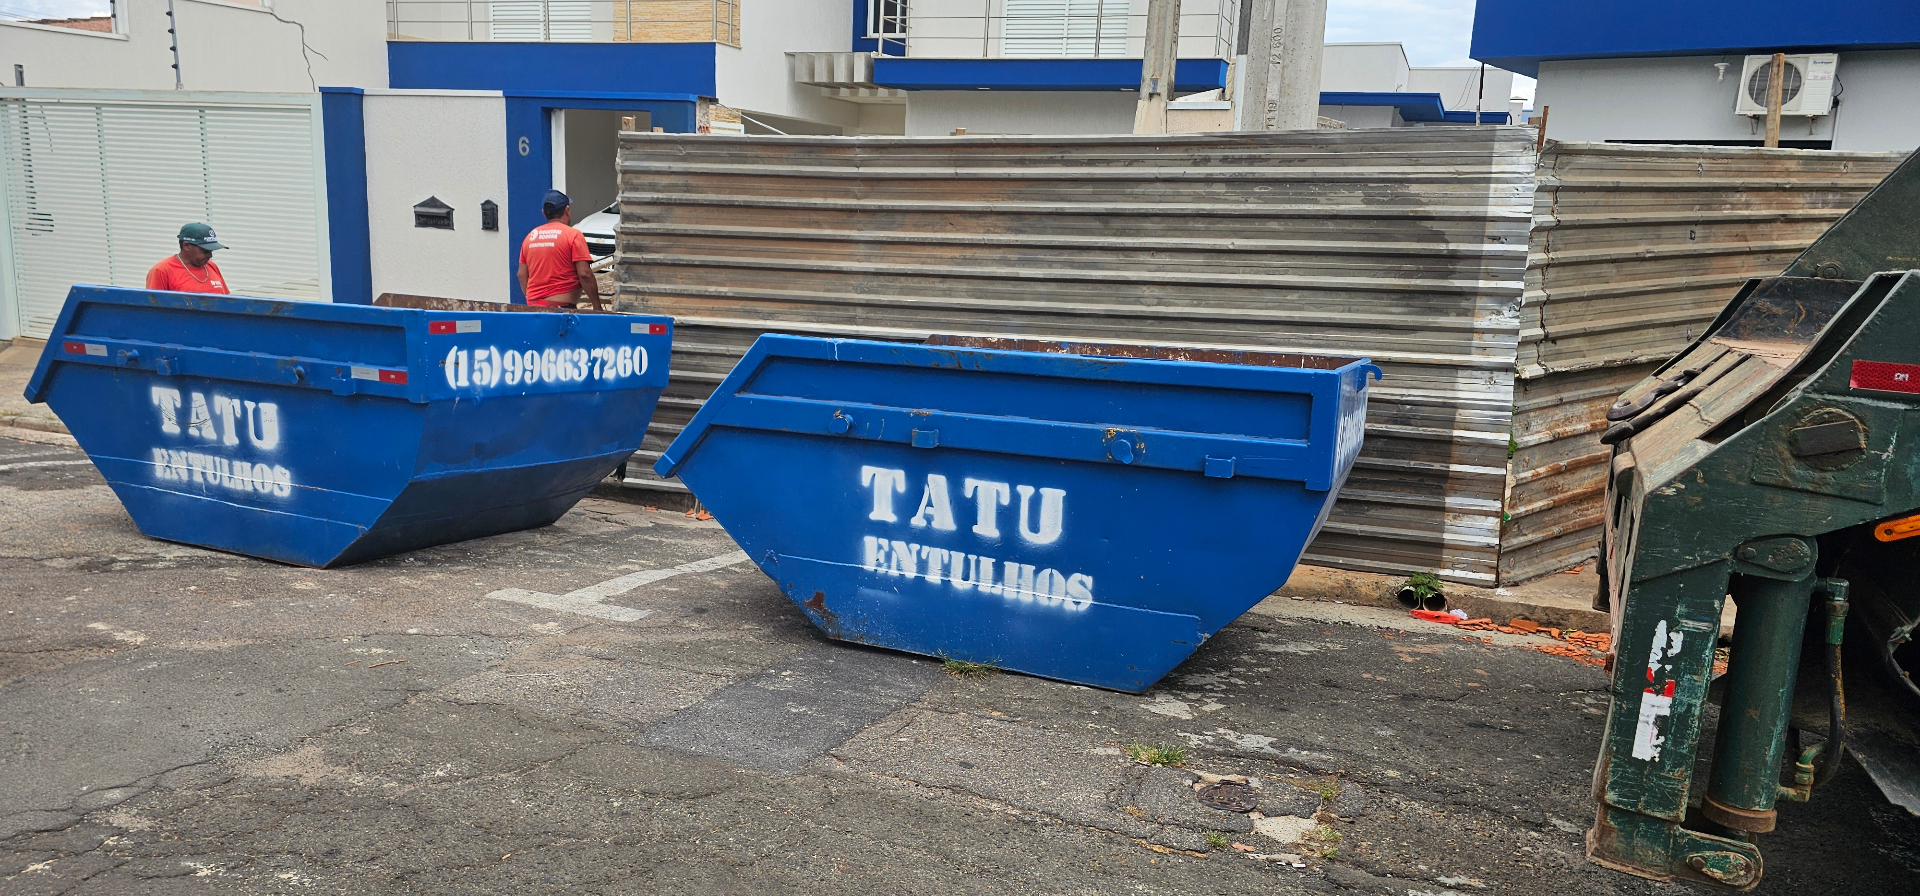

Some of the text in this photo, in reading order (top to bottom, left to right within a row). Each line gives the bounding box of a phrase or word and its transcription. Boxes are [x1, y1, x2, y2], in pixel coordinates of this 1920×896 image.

[518, 136, 530, 157] 6
[151, 386, 280, 450] TATU
[152, 448, 292, 497] ENTULHOS
[861, 465, 1067, 544] TATU
[863, 535, 1093, 611] ENTULHOS
